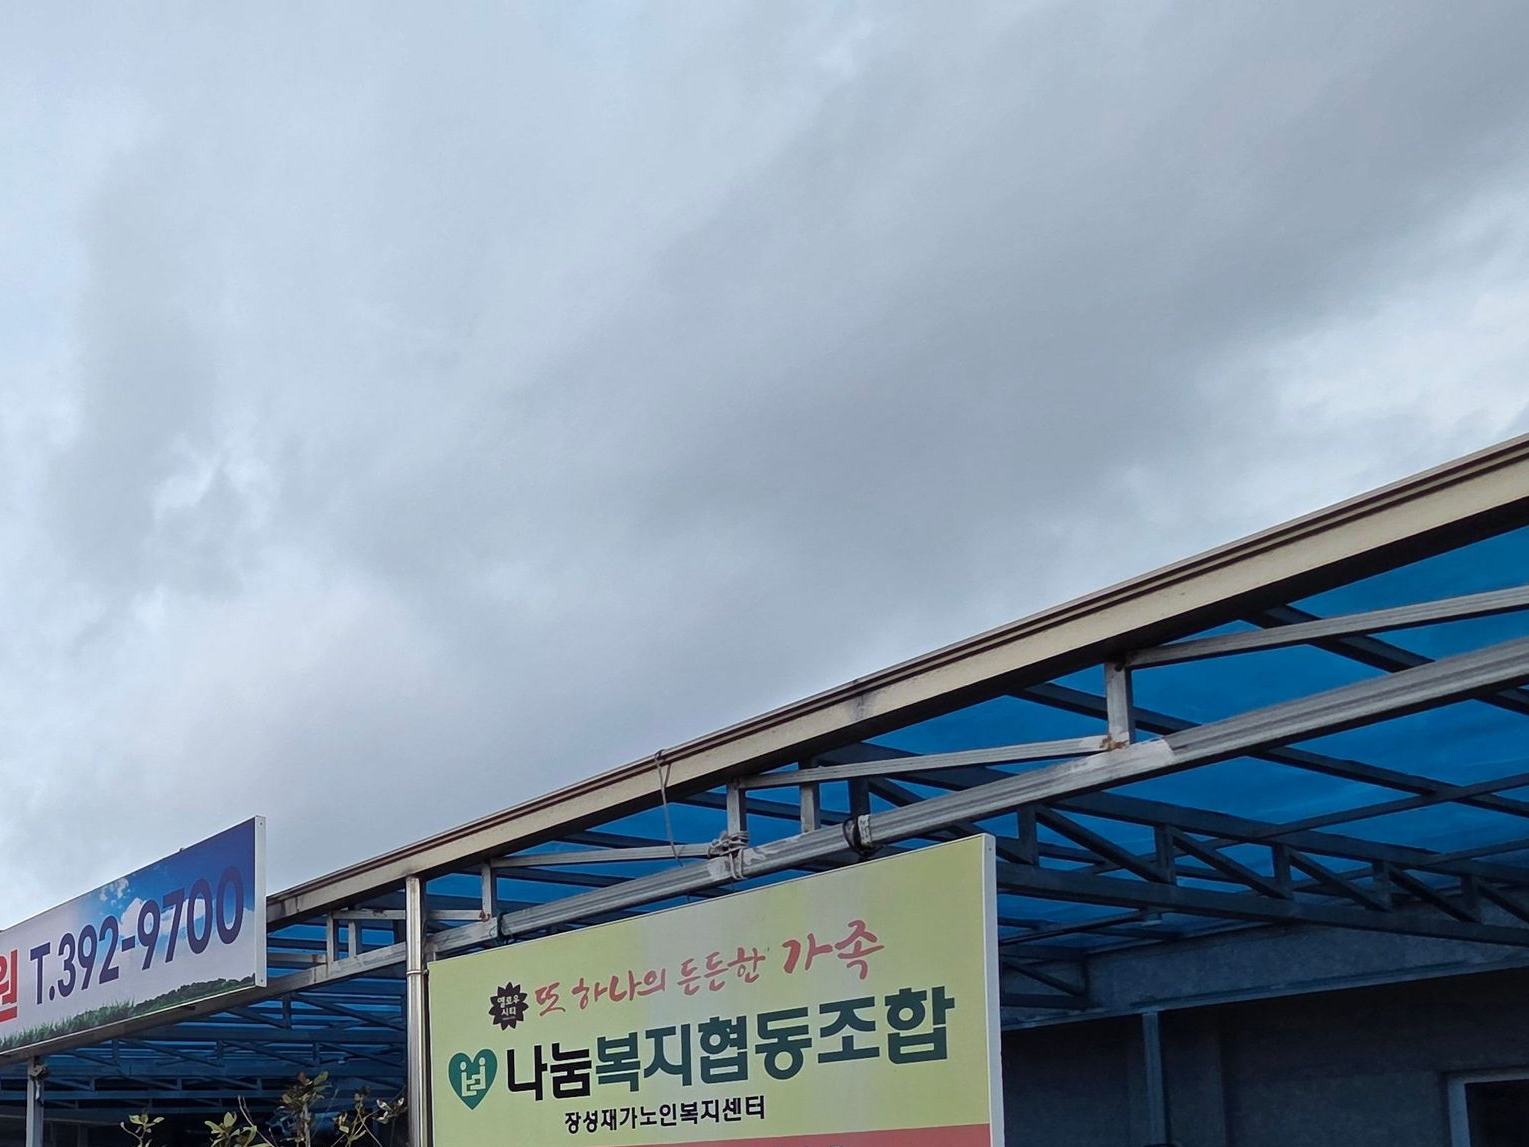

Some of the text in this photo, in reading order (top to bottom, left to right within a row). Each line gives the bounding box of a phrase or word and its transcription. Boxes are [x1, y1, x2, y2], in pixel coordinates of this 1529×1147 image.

[29, 866, 245, 1006] T.392-9700
[535, 919, 885, 1017] 또 하나의 든든한 가족
[506, 986, 955, 1101] 나눔복지협동조합
[564, 1095, 766, 1134] 장성재가노인복지센터
